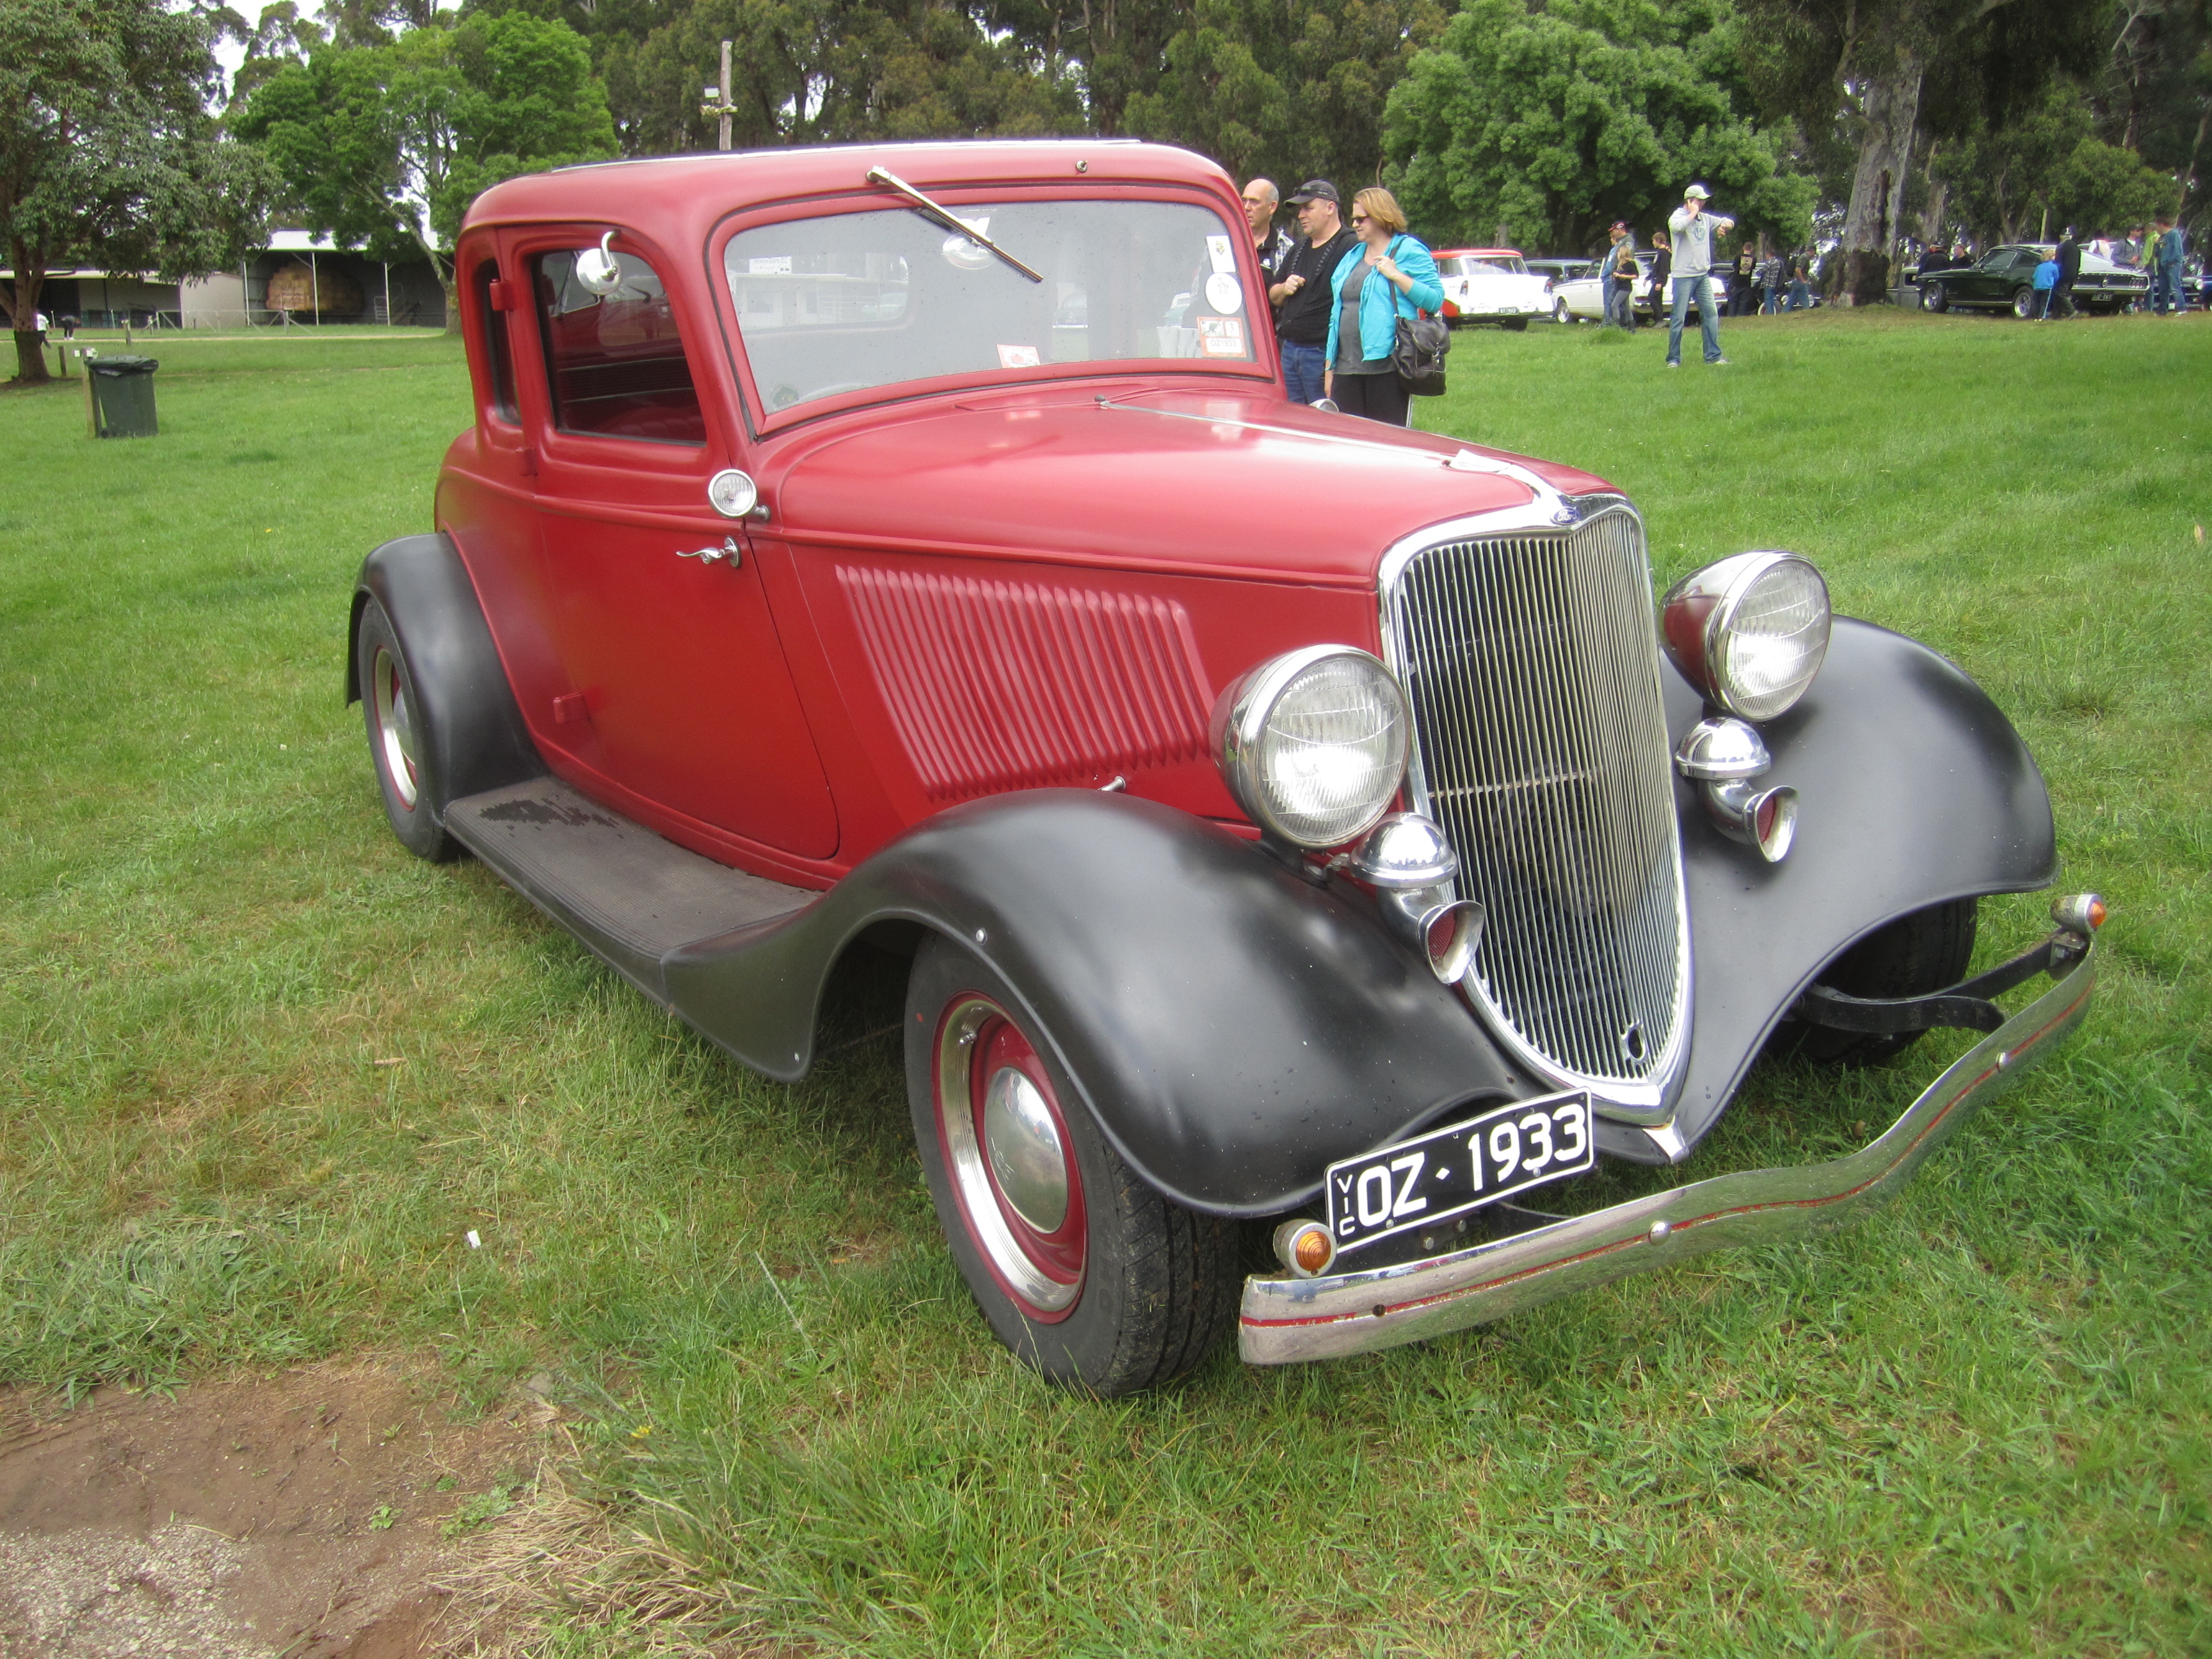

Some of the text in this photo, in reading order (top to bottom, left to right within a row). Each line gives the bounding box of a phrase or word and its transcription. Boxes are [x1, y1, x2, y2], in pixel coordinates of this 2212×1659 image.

[1229, 323, 1235, 333] 3
[1557, 507, 1578, 522] Ford
[1357, 1103, 1587, 1228] OZ 1933
[1336, 1173, 1356, 1237] VIC
